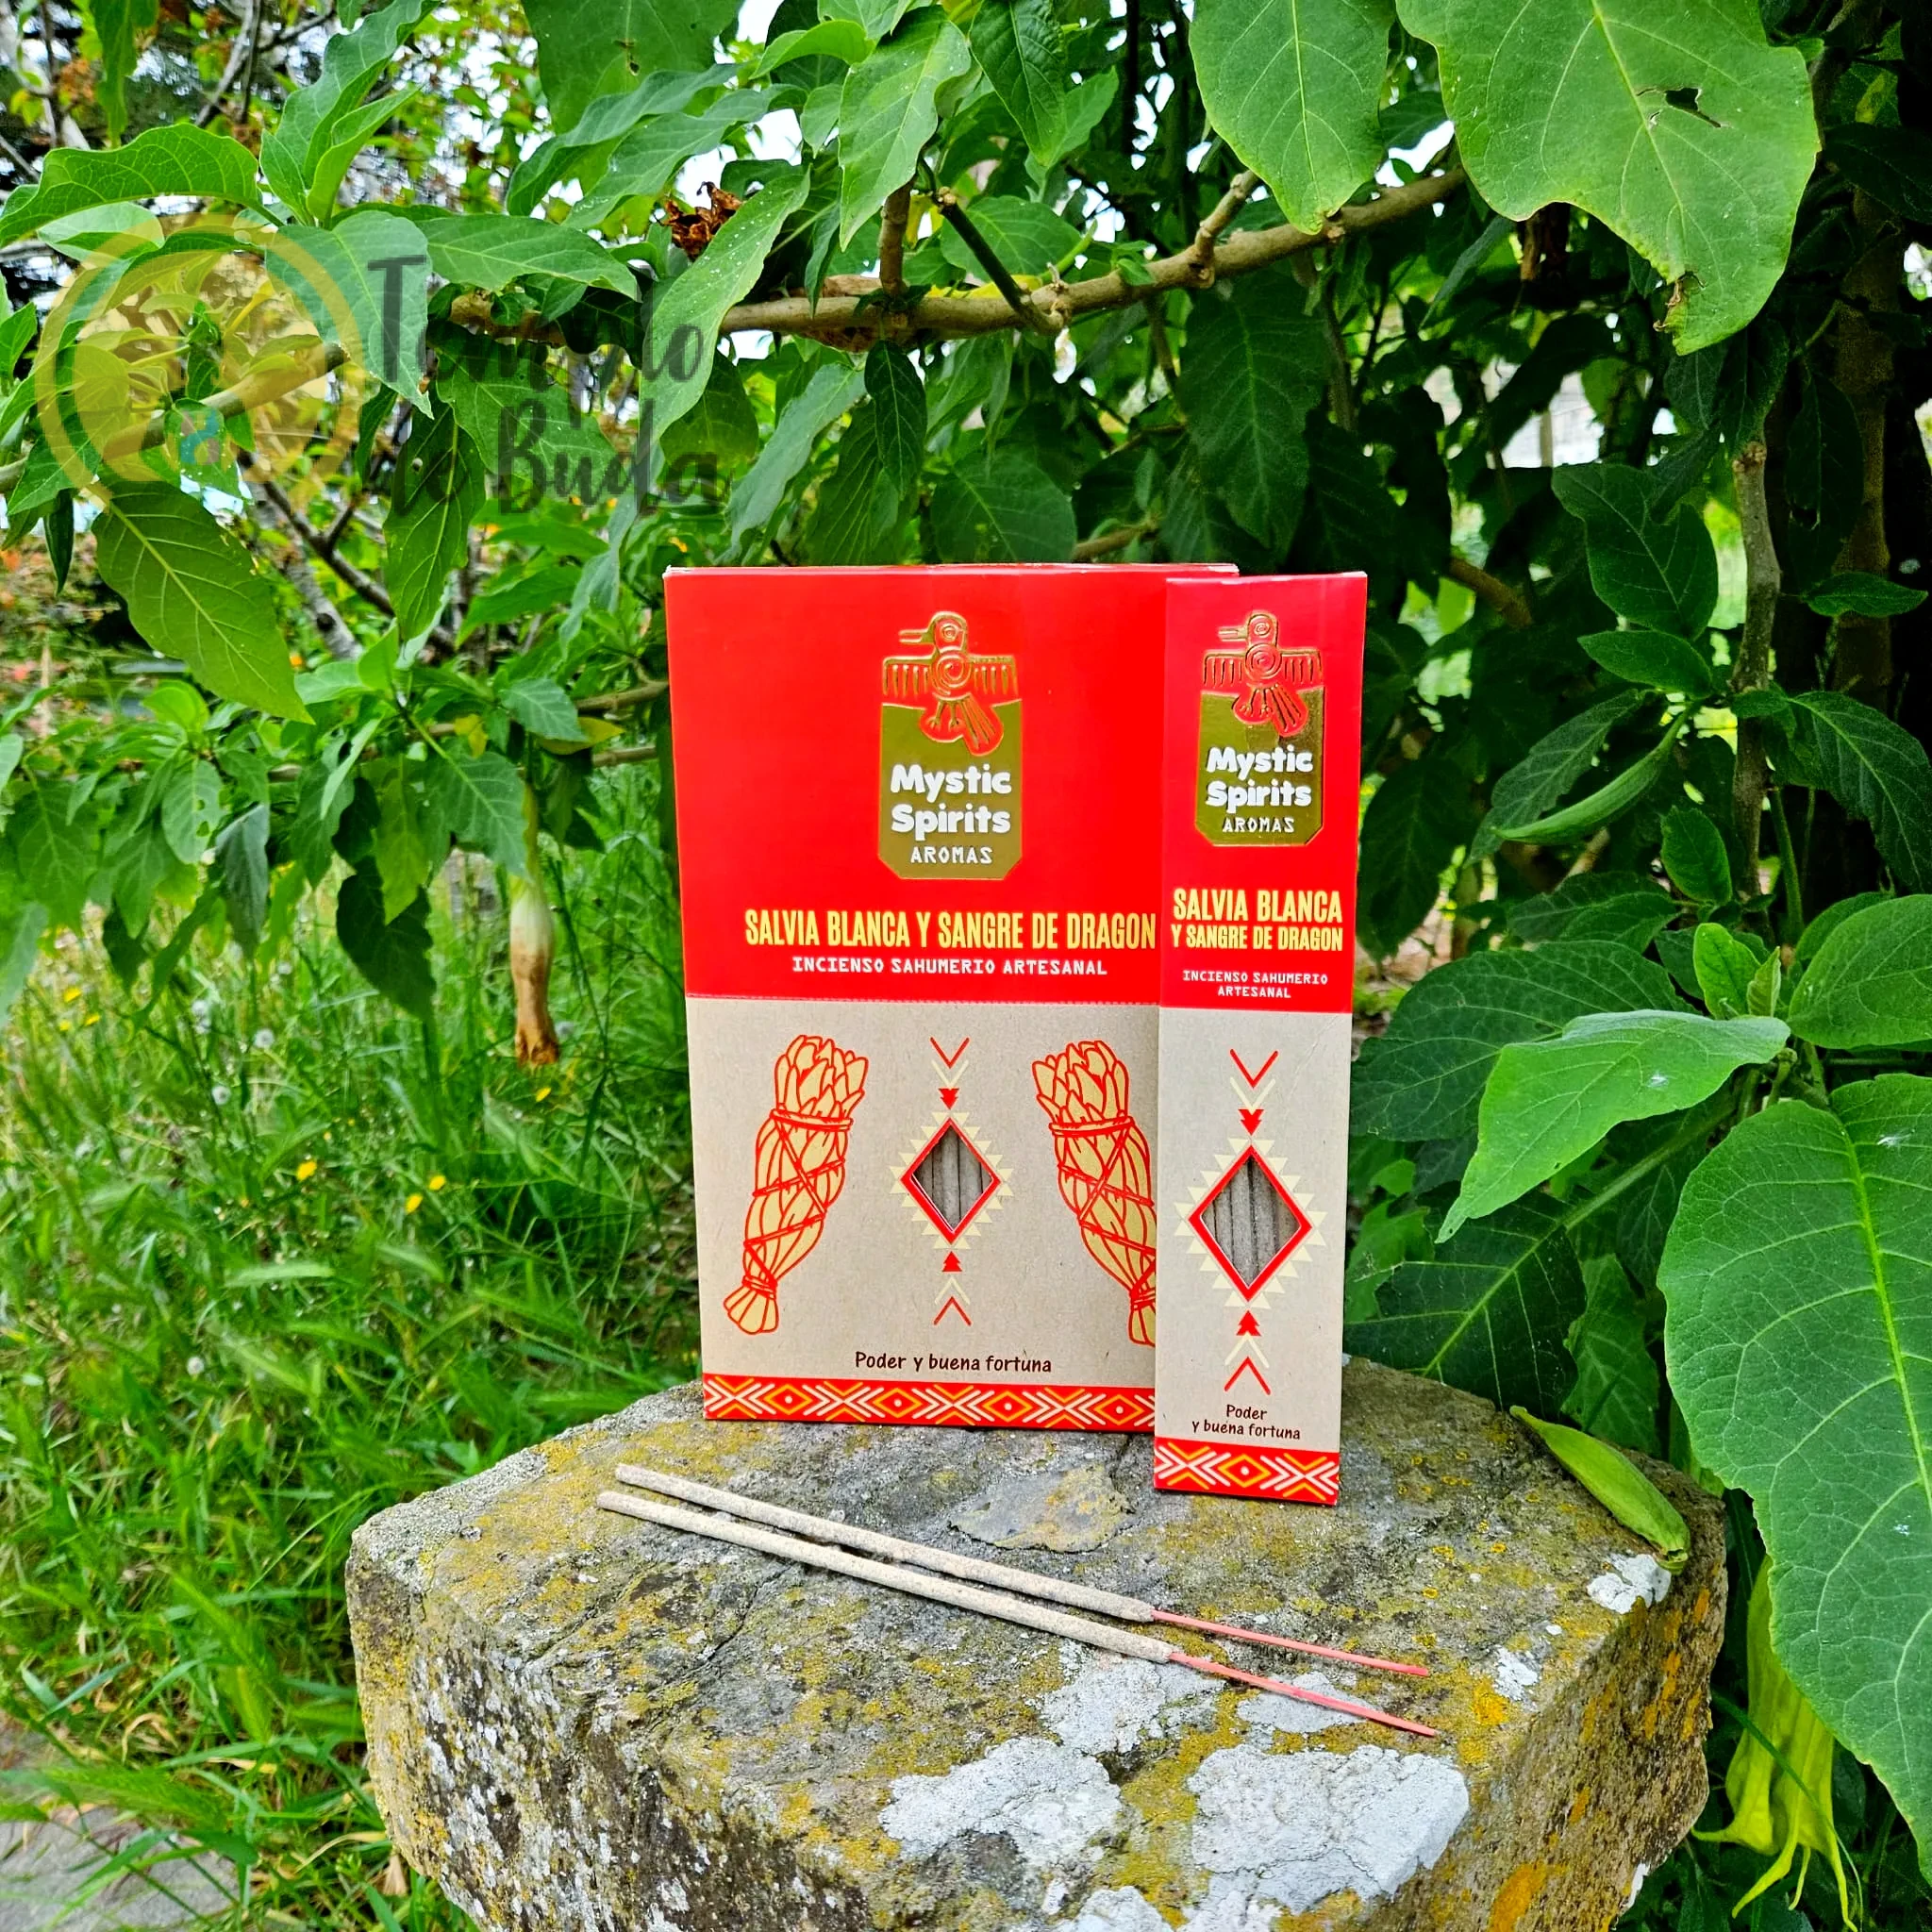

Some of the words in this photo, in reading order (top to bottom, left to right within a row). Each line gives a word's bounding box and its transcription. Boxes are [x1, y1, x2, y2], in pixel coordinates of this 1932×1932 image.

[1206, 744, 1314, 781] Mystic
[890, 763, 1012, 803] Mystic
[1205, 778, 1312, 814] Spirits
[891, 803, 1011, 841] Spirits
[1222, 817, 1294, 833] AROMAS
[910, 845, 992, 864] AROMAS
[1173, 887, 1249, 922] SALVIA
[1257, 890, 1343, 924] BLANCA
[744, 908, 820, 946] SALVIA
[827, 910, 911, 948] BLANCA
[915, 911, 931, 948] Y
[938, 910, 1024, 949] SANGRE
[1032, 912, 1058, 949] DE
[1066, 912, 1157, 949] DRAGON
[1171, 924, 1182, 948] Y
[1186, 924, 1248, 950] SANGRE
[1253, 926, 1273, 950] DE
[1277, 927, 1343, 952] DRAGON
[791, 956, 885, 974] INCIENSO
[891, 958, 996, 975] SAHUMERIO
[1002, 958, 1108, 975] ARTESANAL
[1182, 969, 1249, 983] INCIENSO
[1252, 972, 1329, 986] SAHUMERIO
[1217, 985, 1292, 999] ARTESANAL
[855, 1351, 907, 1369] Poder
[912, 1356, 924, 1373] y
[927, 1353, 980, 1372] buena
[985, 1355, 1053, 1374] fortuna
[1226, 1404, 1268, 1421] Poder
[1191, 1421, 1200, 1434] y
[1203, 1418, 1244, 1436] buena
[1247, 1423, 1301, 1441] fortuna
